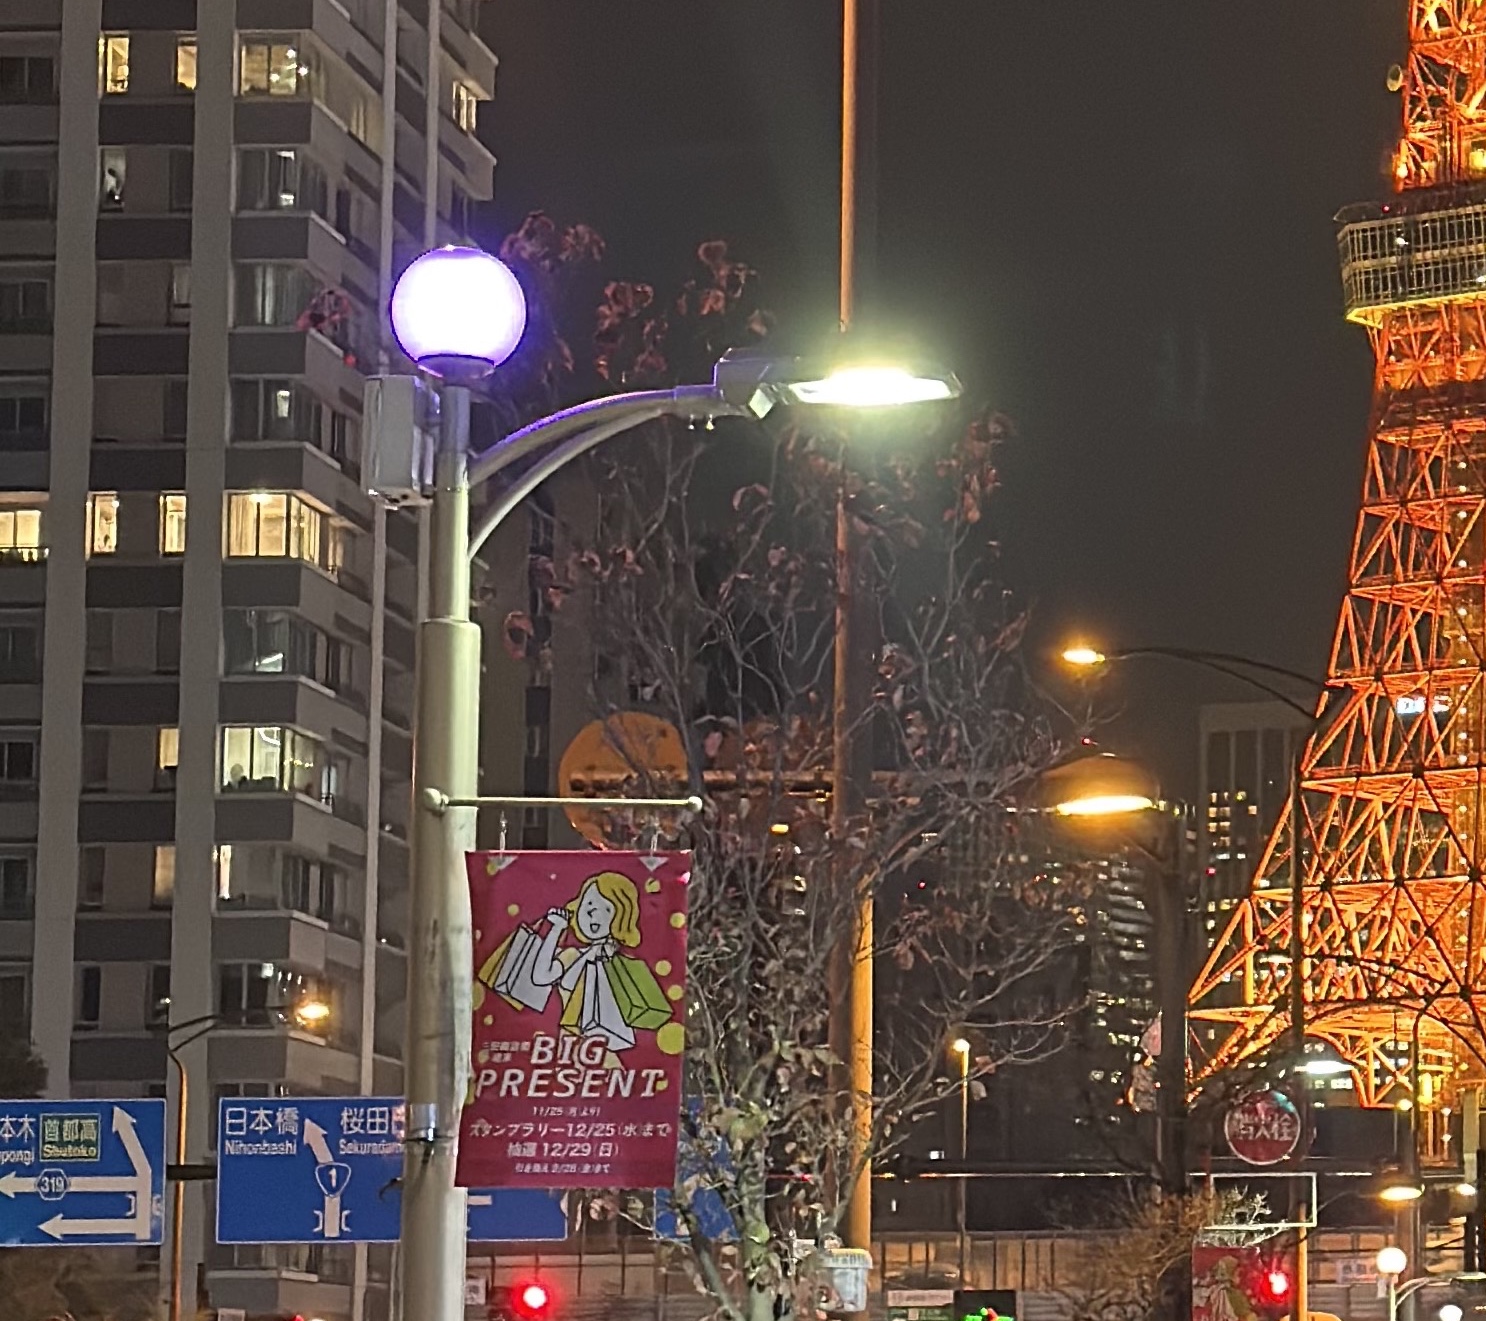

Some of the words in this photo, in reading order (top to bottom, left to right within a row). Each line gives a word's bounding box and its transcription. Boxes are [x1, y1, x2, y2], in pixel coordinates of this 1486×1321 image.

[530, 1035, 608, 1065] BIG
[475, 1068, 665, 1099] PRESENT
[0, 1113, 36, 1144] 本木
[226, 1106, 299, 1136] 日本橋
[0, 1147, 34, 1166] pongi
[225, 1139, 298, 1155] Nihonbashi
[40, 1176, 65, 1193] 319
[328, 1167, 337, 1189] 1
